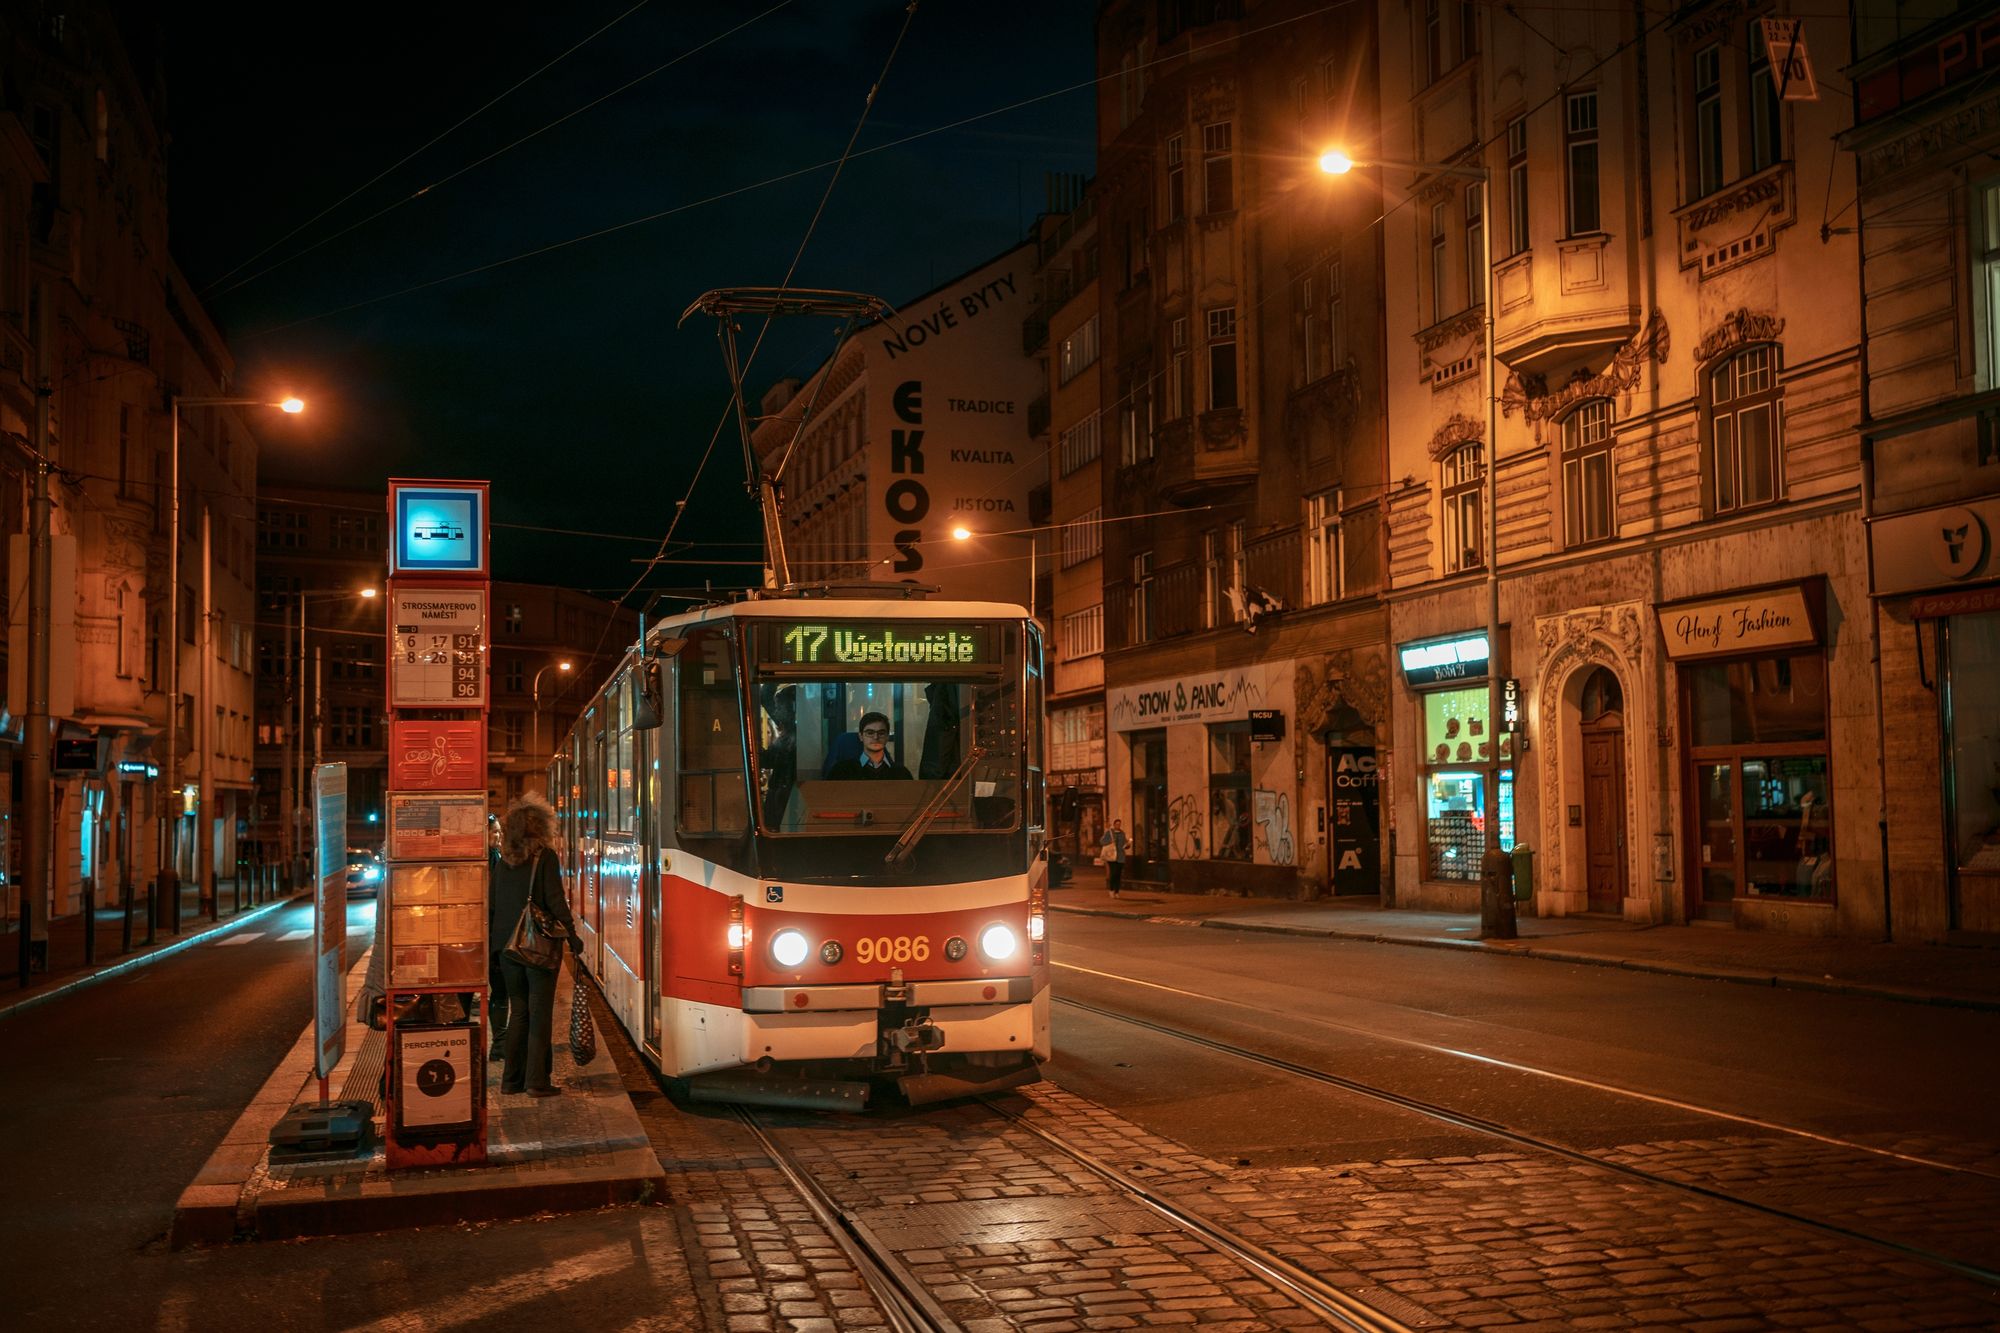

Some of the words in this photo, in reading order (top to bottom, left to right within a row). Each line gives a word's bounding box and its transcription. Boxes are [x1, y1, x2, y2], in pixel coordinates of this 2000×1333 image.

[883, 301, 958, 360] NOVÉ
[960, 272, 1017, 318] BYTY
[948, 398, 1015, 414] TRADICE
[950, 449, 1015, 465] KVALITA
[886, 380, 931, 584] EKOS
[952, 497, 1015, 513] JISTOTA
[402, 602, 477, 611] STROSSMAYEROVO
[1732, 605, 1793, 639] Fashion
[407, 636, 416, 648] 6
[431, 636, 448, 648] 17
[458, 635, 475, 649] 91
[784, 625, 828, 662] 17
[834, 630, 974, 663] Výstaviště
[407, 651, 416, 664] 8
[431, 651, 448, 664] 26
[458, 652, 475, 665] 93
[458, 667, 476, 681] 94
[458, 683, 475, 697] 96
[1190, 682, 1226, 711] PANIC
[1504, 680, 1518, 732] SUSHI
[1252, 711, 1273, 720] NCSU
[711, 718, 722, 733] A
[856, 935, 930, 965] 9086
[451, 1039, 468, 1047] BOD
